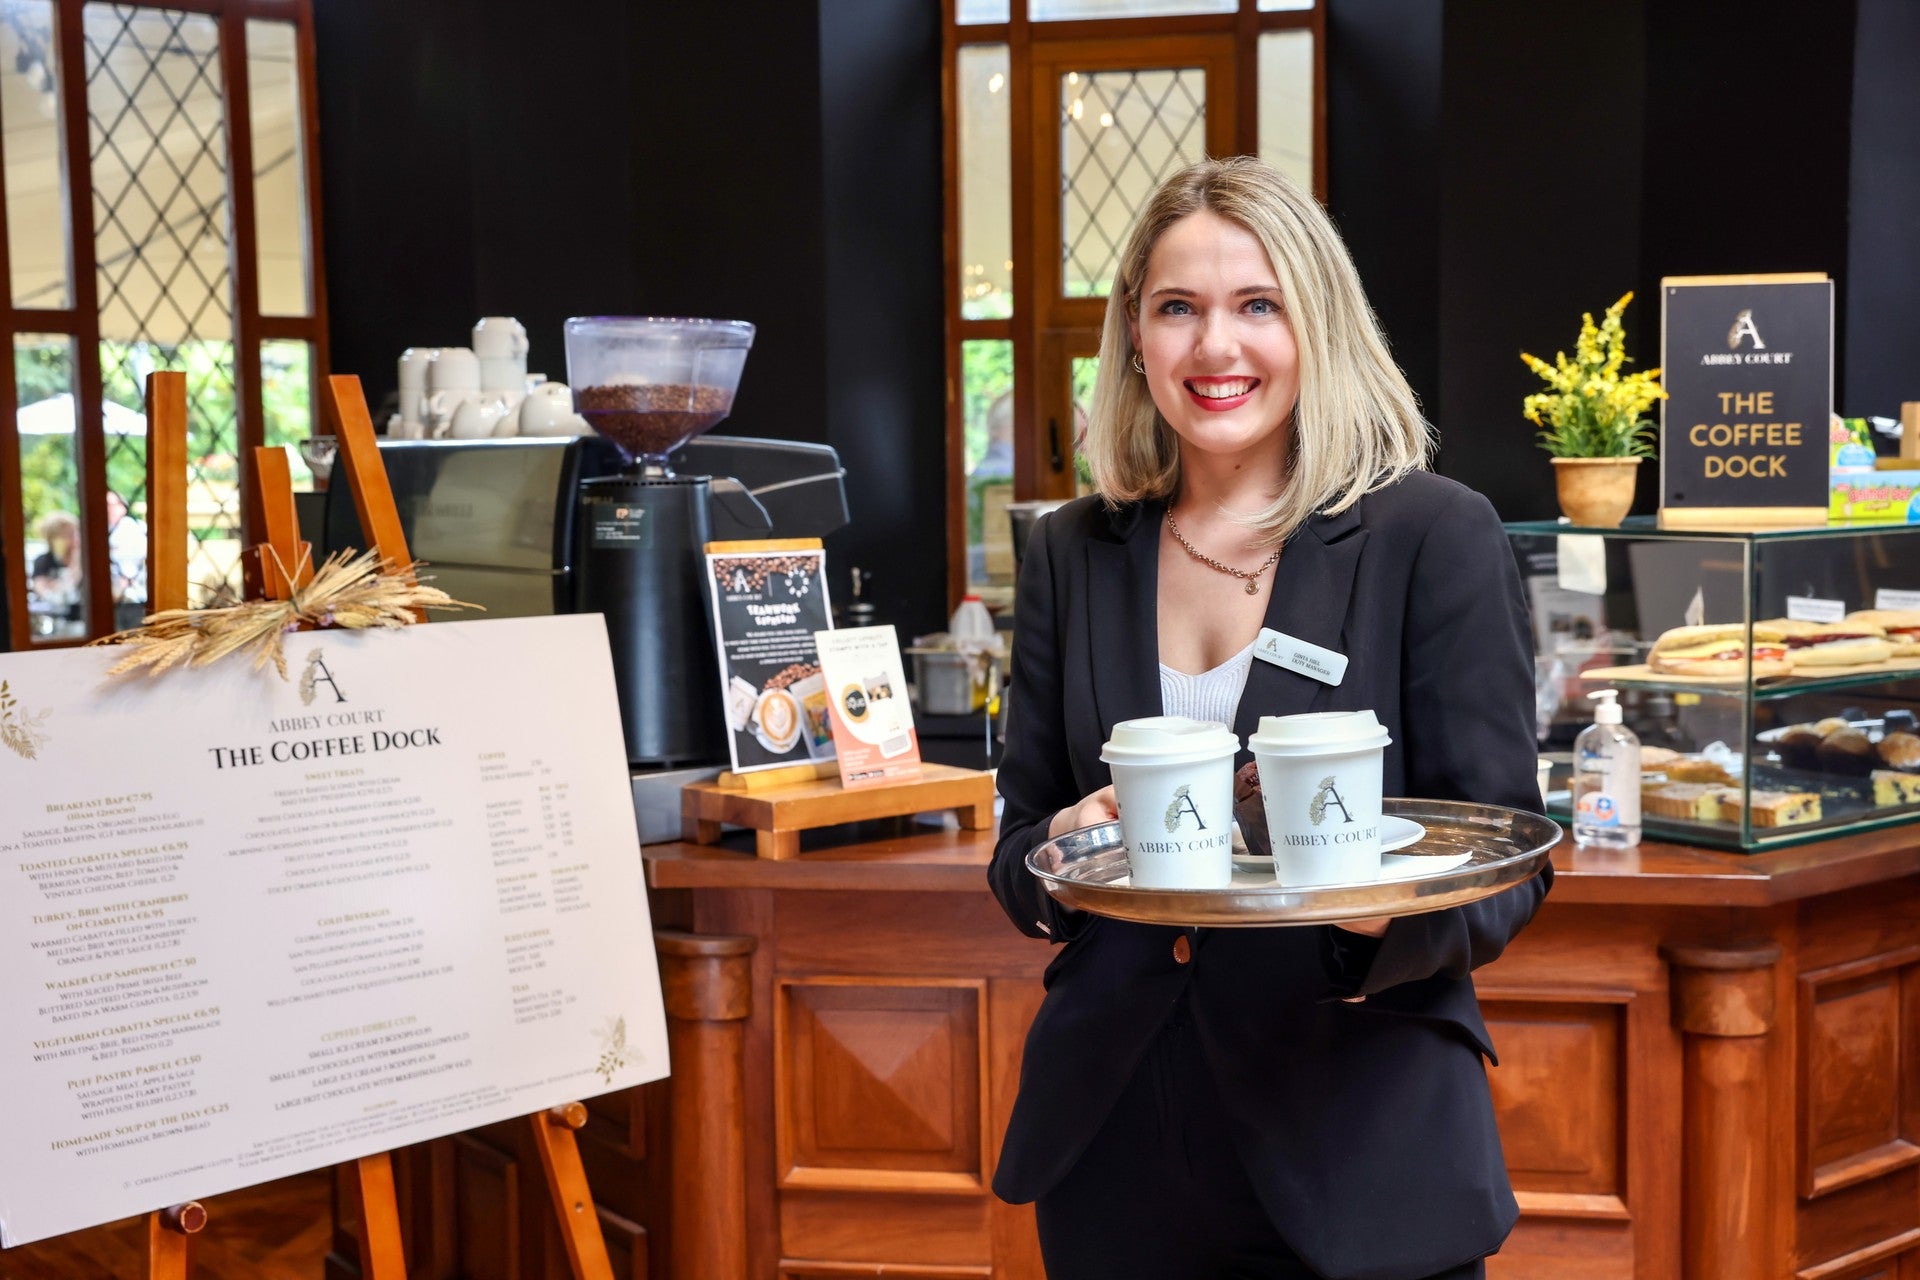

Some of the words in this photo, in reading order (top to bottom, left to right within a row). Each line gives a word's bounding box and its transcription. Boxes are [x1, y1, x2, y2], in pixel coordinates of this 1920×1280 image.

[1701, 353, 1742, 365] ABBEY
[1745, 352, 1793, 364] COURT
[1718, 392, 1774, 414] THE
[1689, 423, 1802, 446] COFFEE
[1705, 455, 1787, 478] DOCK
[267, 715, 321, 732] ABBEY
[326, 709, 385, 727] COURT
[208, 743, 262, 769] THE
[270, 733, 364, 763] COFFEE
[372, 725, 441, 751] DOCK
[45, 799, 101, 812] BREAKFAST
[105, 796, 124, 805] BAP
[1137, 841, 1185, 854] ABBEY
[1188, 834, 1230, 851] COURT
[1283, 833, 1330, 847] ABBEY
[1334, 826, 1378, 845] COURT
[18, 857, 67, 871] TOASTED
[68, 850, 118, 864] CIABATTA
[120, 845, 158, 857] SPECIAL
[78, 906, 100, 917] BRIE
[103, 902, 129, 913] WITH
[131, 893, 189, 909] CRANBERRY
[66, 921, 83, 931] ON
[84, 913, 134, 928] CIABATTA
[44, 975, 88, 991] WALKER
[89, 971, 112, 983] CUP
[113, 961, 168, 979] SANDWICH
[33, 1029, 99, 1050] VEGETARIAN
[101, 1019, 151, 1037] CIABATTA
[153, 1012, 190, 1027] SPECIAL
[67, 1076, 92, 1090] PUFF
[95, 1068, 132, 1084] PASTRY
[135, 1060, 171, 1076] PARCEL
[50, 1128, 112, 1151] HOMEMADE
[115, 1122, 142, 1136] SOUP
[143, 1118, 157, 1129] OF
[160, 1114, 178, 1126] THE
[180, 1109, 201, 1121] DAY
